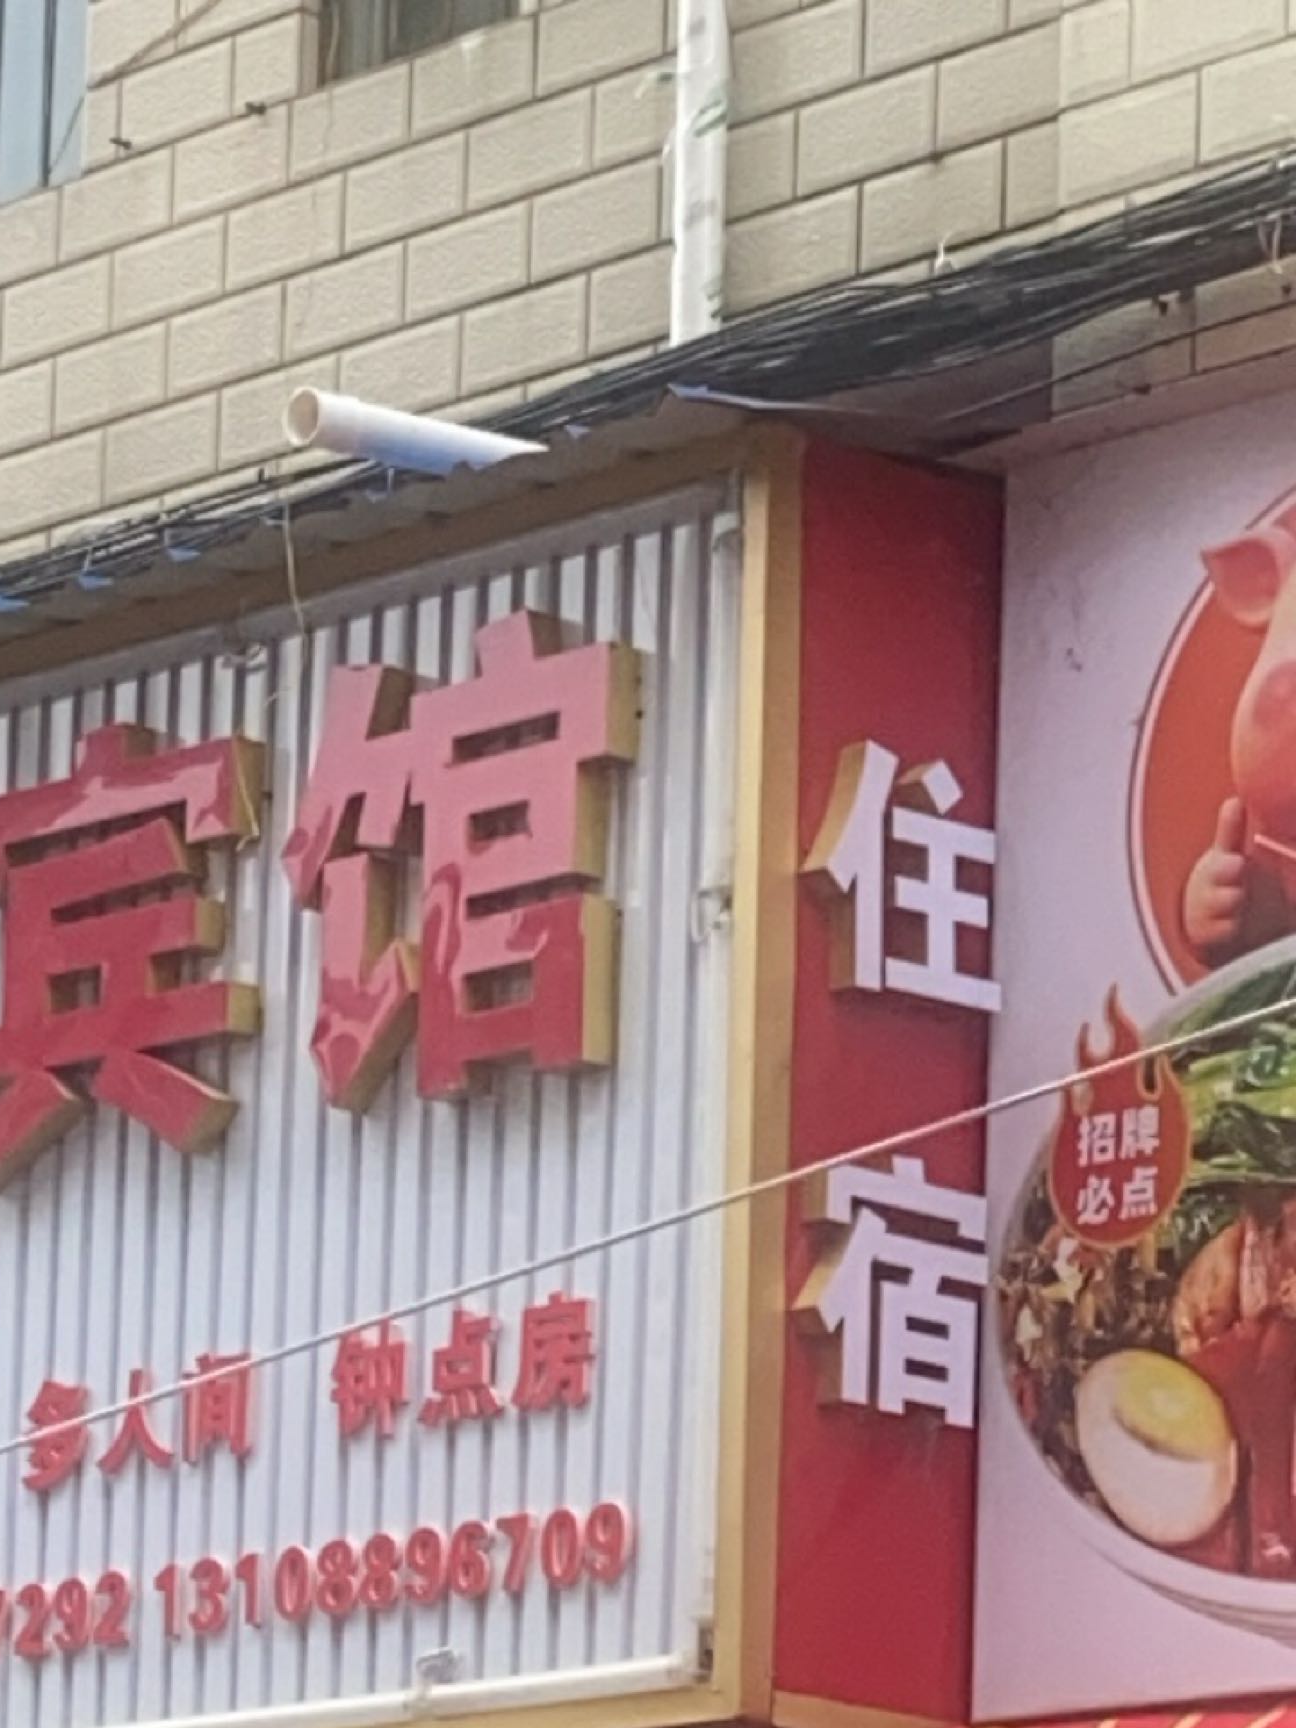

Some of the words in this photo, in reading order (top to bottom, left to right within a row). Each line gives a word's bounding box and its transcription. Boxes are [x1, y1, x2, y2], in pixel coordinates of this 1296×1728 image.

[800, 740, 1002, 1430] 住宿
[1077, 1104, 1161, 1166] 招牌
[1075, 1166, 1160, 1226] 必点
[22, 1350, 255, 1492] 多人间
[330, 1290, 596, 1440] 钟点房
[154, 1500, 638, 1641] 13108896709
